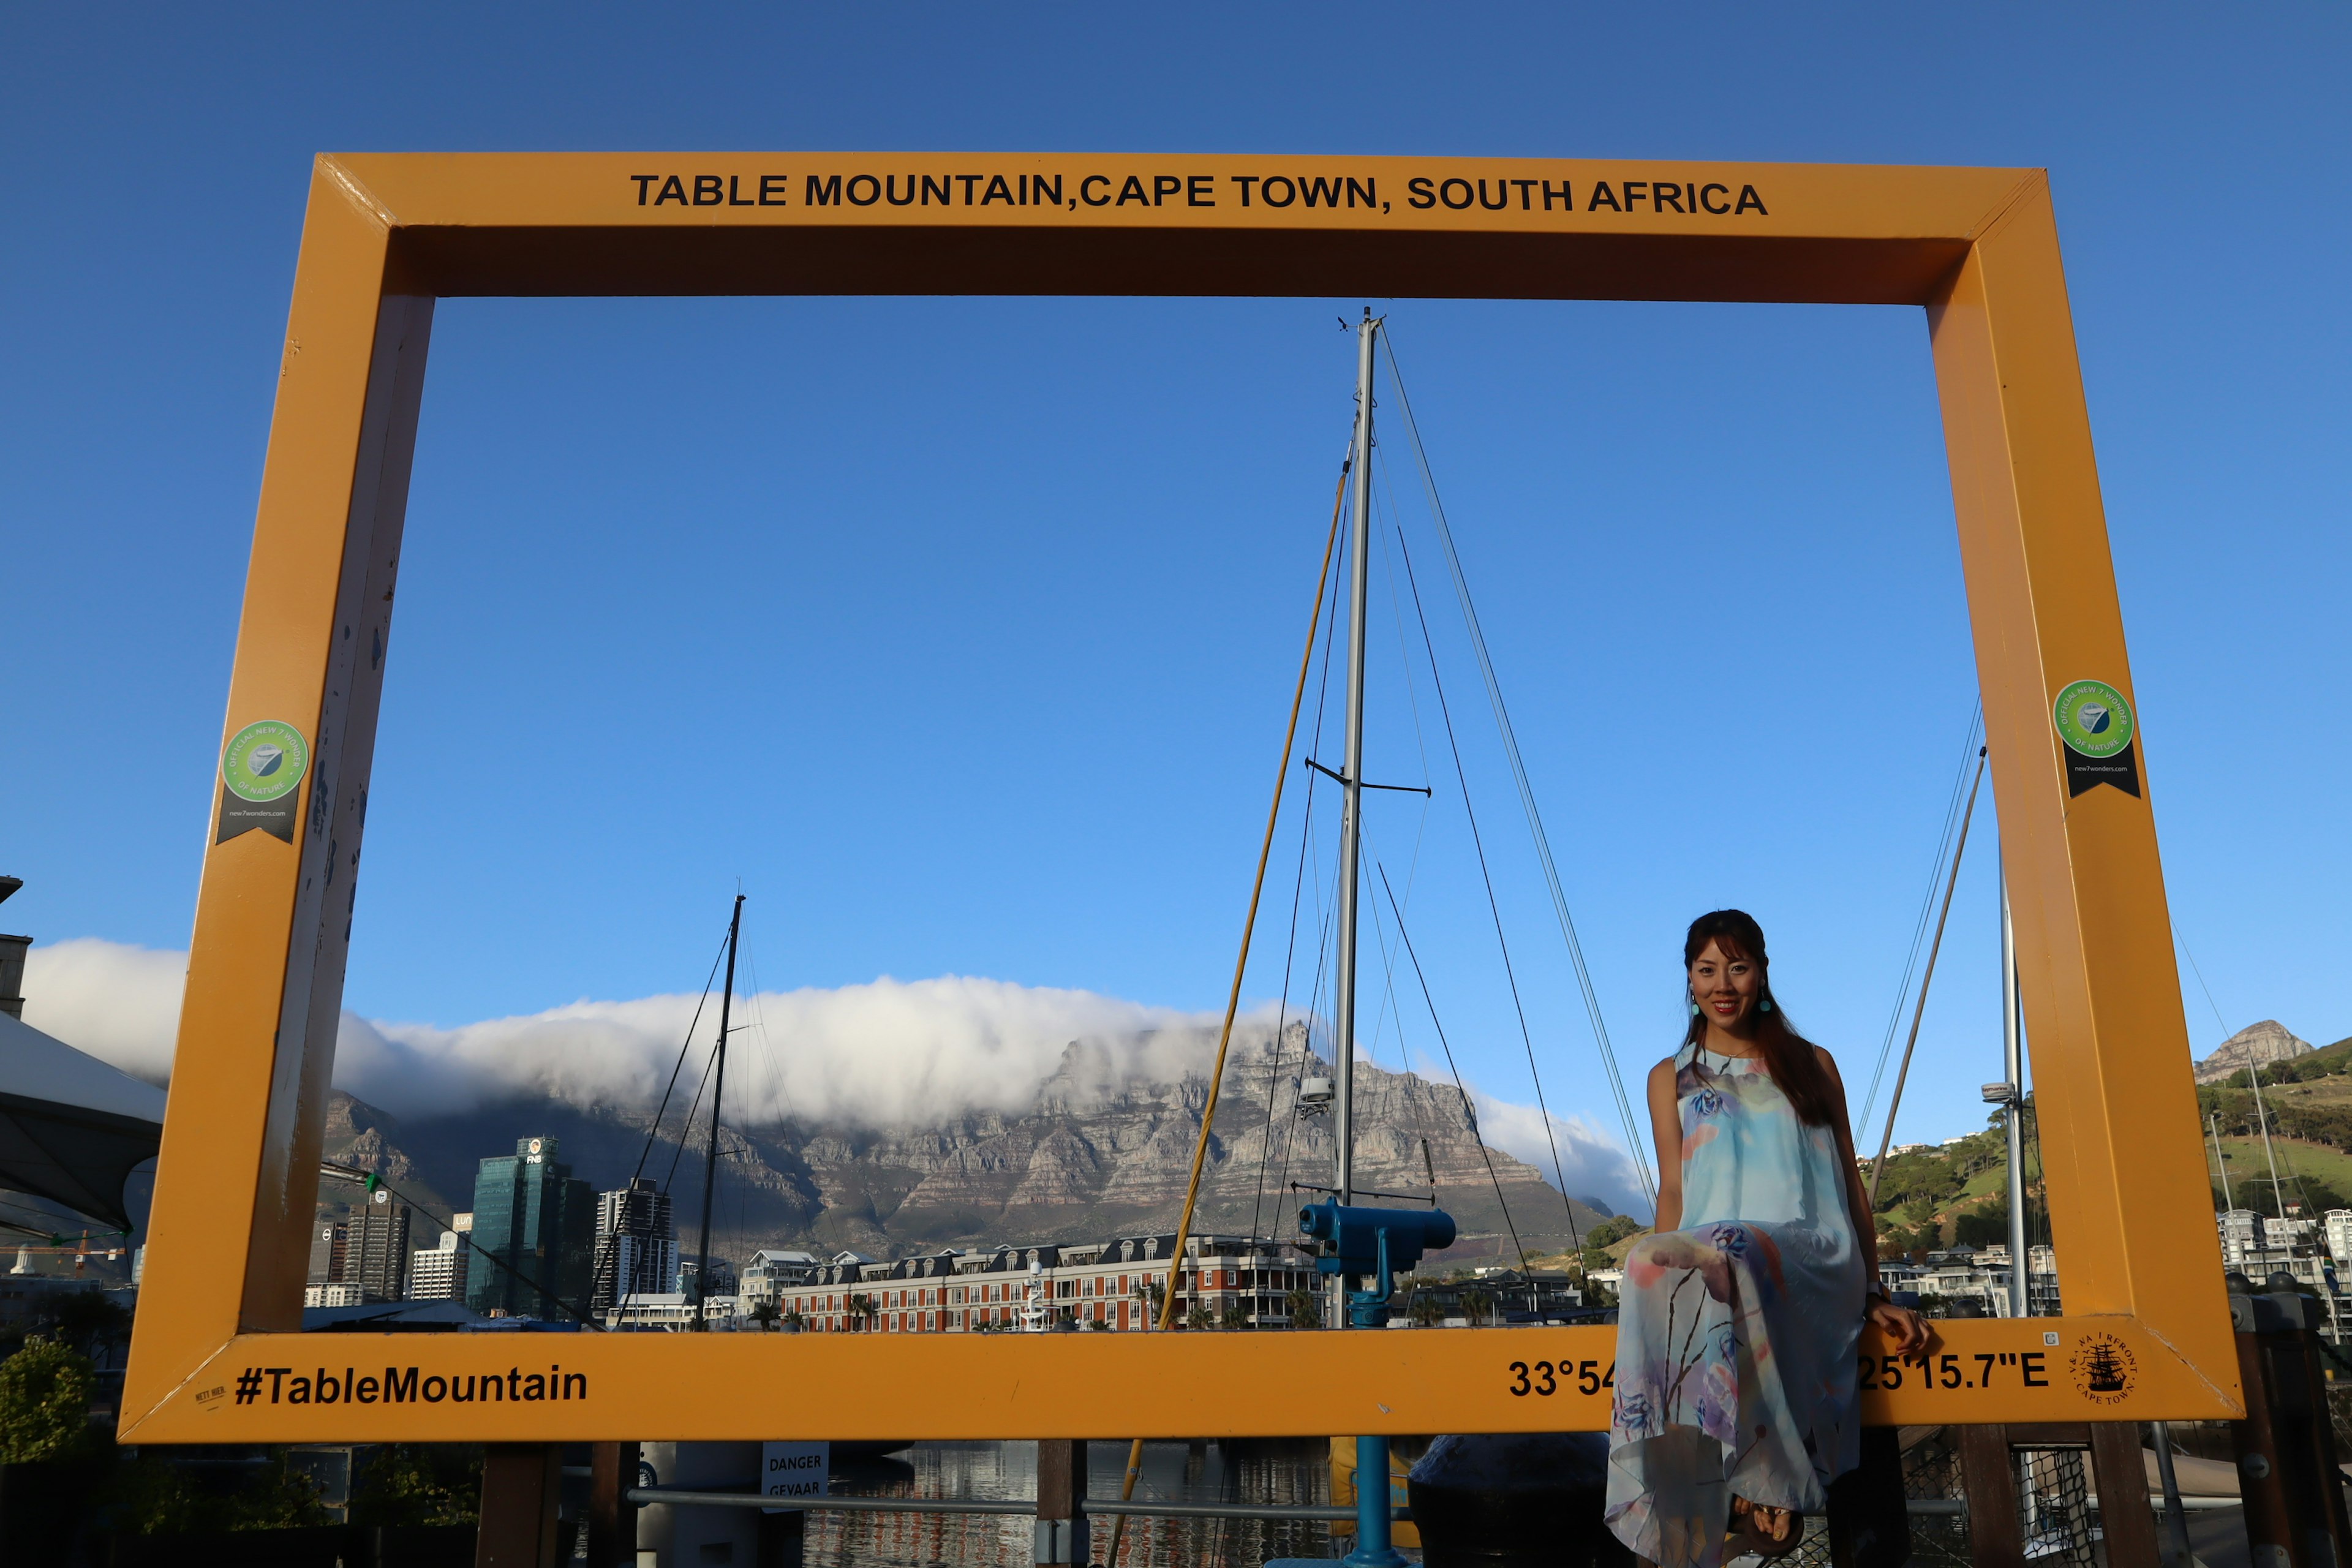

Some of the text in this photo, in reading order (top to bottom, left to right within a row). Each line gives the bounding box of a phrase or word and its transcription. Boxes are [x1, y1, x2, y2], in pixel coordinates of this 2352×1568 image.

[630, 175, 788, 206] TABLE
[1231, 176, 1391, 214] TOWN,
[1408, 178, 1574, 211] SOUTH
[1588, 181, 1769, 216] AFRICA
[2060, 692, 2078, 725] OFFICIAL
[2106, 692, 2127, 725] WONDER
[229, 733, 255, 767] OFFICIAL
[255, 726, 277, 736] NEW
[284, 732, 301, 767] WONDER
[2075, 737, 2120, 752] OF NATURE
[238, 781, 285, 795] OF NATURE
[527, 1155, 541, 1164] FNB
[236, 1365, 587, 1405] #TableMountain
[2076, 1382, 2135, 1405] CAPE TOWN
[769, 1455, 821, 1472] DANGER
[769, 1482, 820, 1496] GEVAAR
